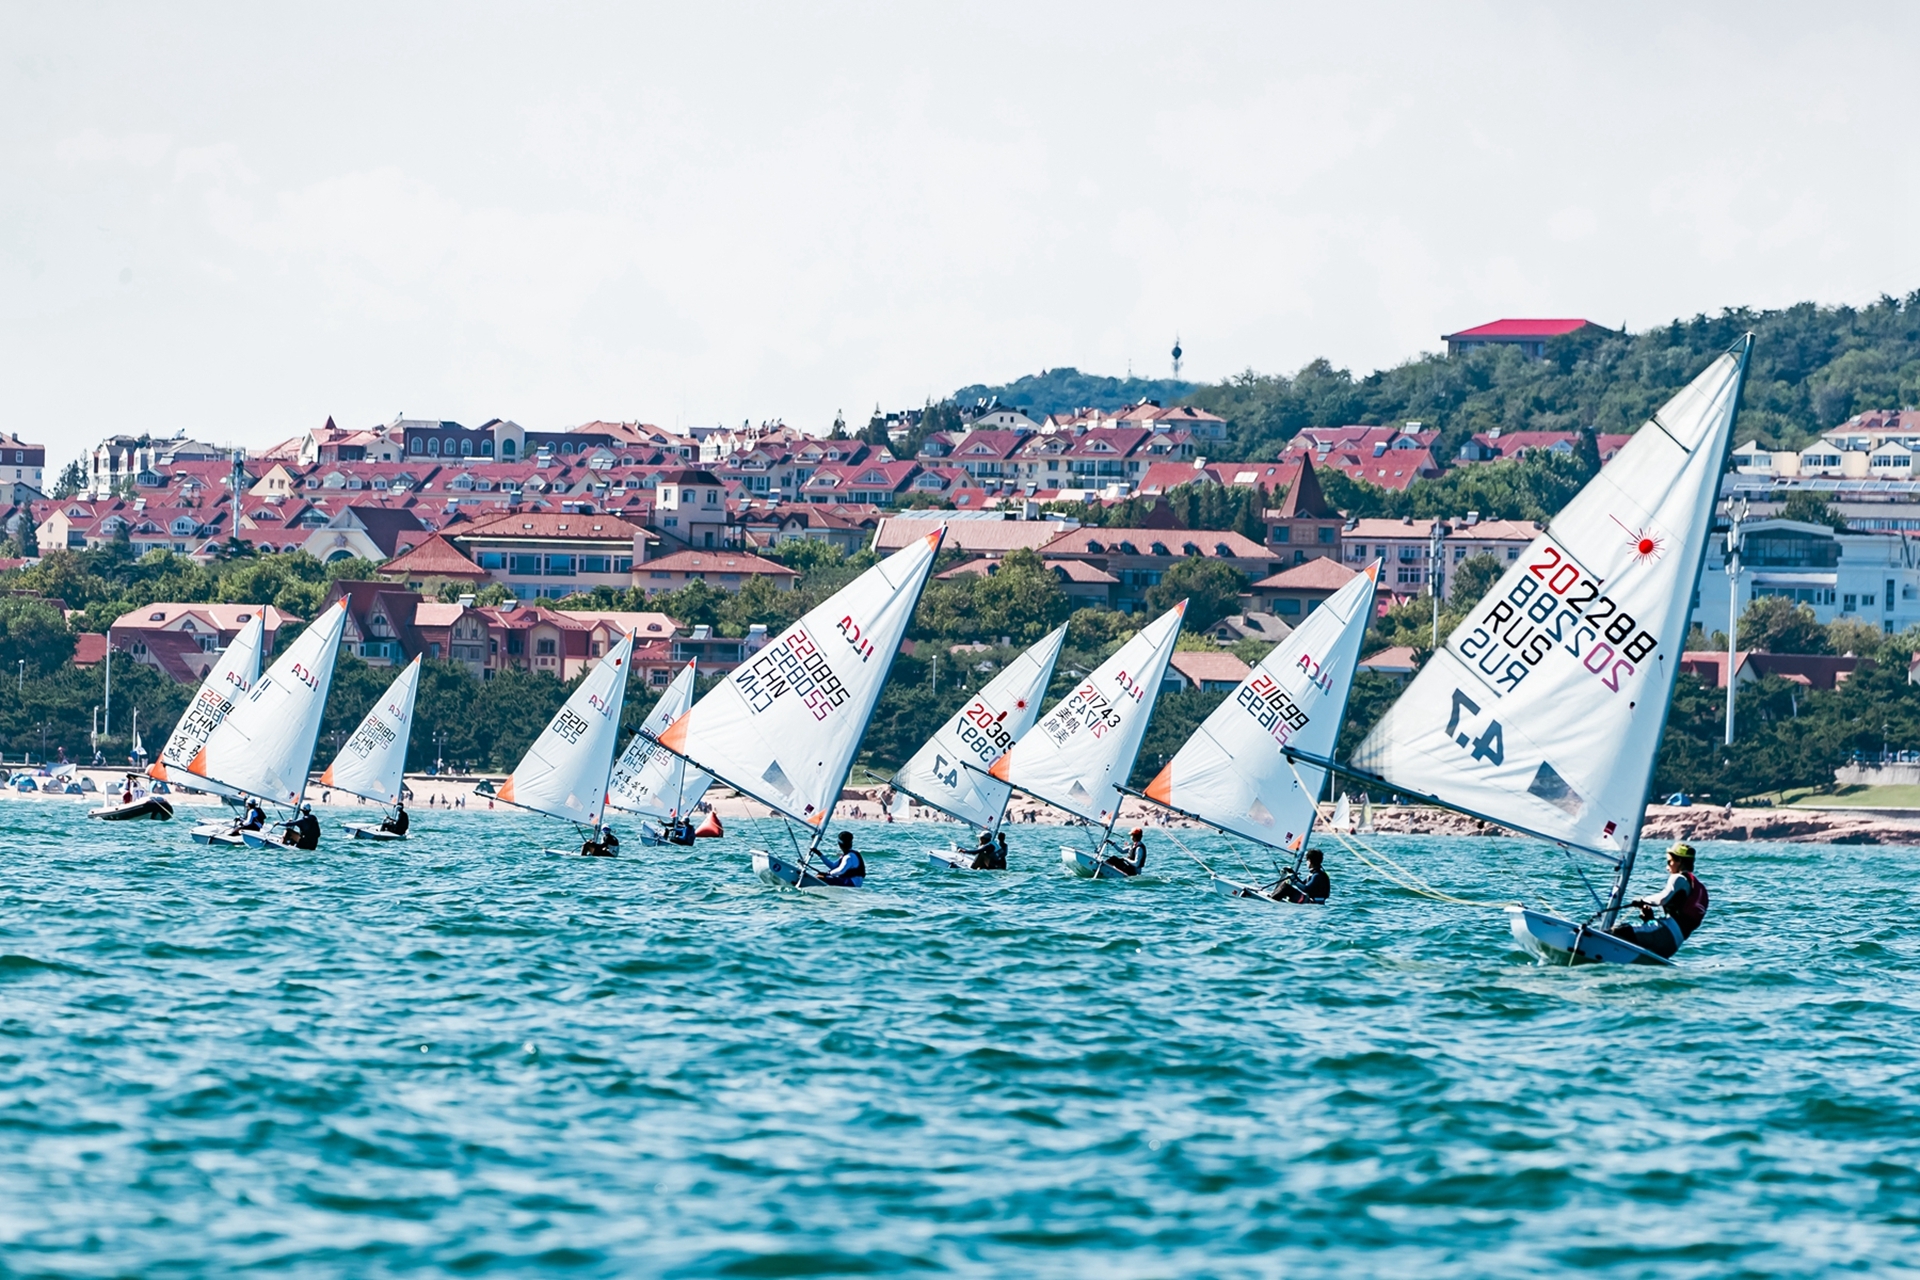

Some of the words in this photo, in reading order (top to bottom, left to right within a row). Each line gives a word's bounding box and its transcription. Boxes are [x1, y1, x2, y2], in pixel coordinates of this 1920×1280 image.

[1529, 546, 1658, 665] 202288
[1482, 600, 1552, 666] RUS
[752, 656, 791, 698] CHN
[786, 629, 851, 707] 220895
[201, 689, 235, 715] 2218
[1079, 685, 1121, 728] 211743
[1251, 675, 1310, 731] 211699
[188, 710, 218, 732] CHN
[367, 716, 396, 742] 219180
[560, 709, 588, 735] 220
[1056, 707, 1081, 734] 美帆
[355, 731, 376, 750] CHN
[629, 745, 650, 764] CHN
